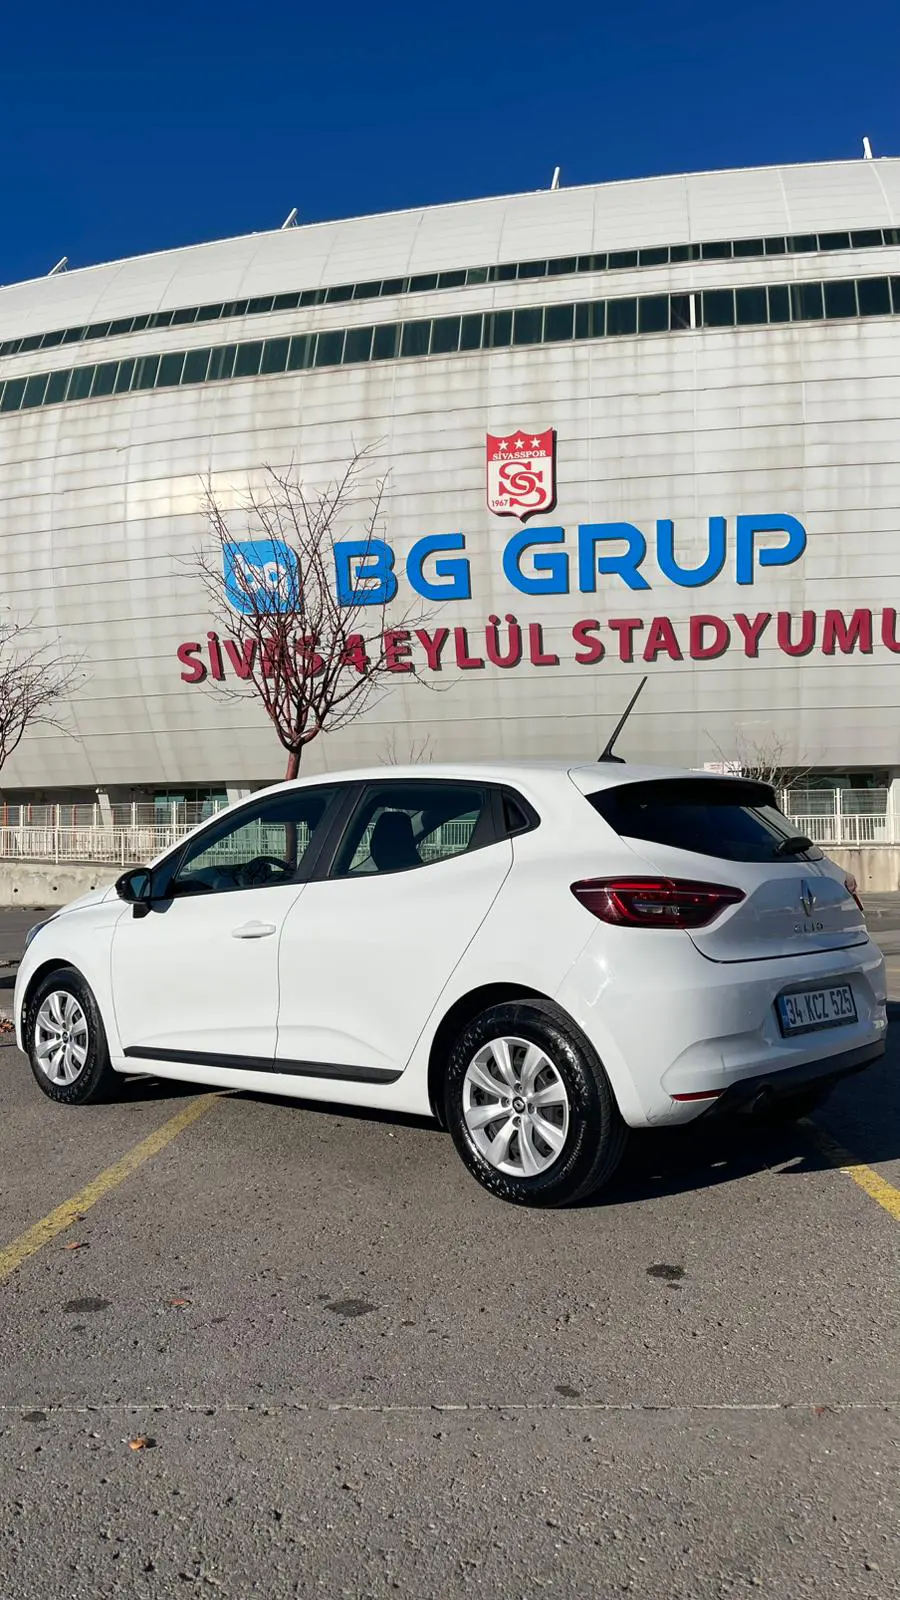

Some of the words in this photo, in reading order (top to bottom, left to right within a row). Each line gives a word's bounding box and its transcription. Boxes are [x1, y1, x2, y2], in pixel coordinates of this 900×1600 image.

[491, 499, 509, 507] 1967
[333, 532, 472, 607] BG
[502, 512, 807, 595] GRUP
[384, 613, 560, 673] EYLÜL
[785, 997, 804, 1025] 34
[804, 992, 830, 1022] KCZ
[830, 988, 853, 1016] 525
